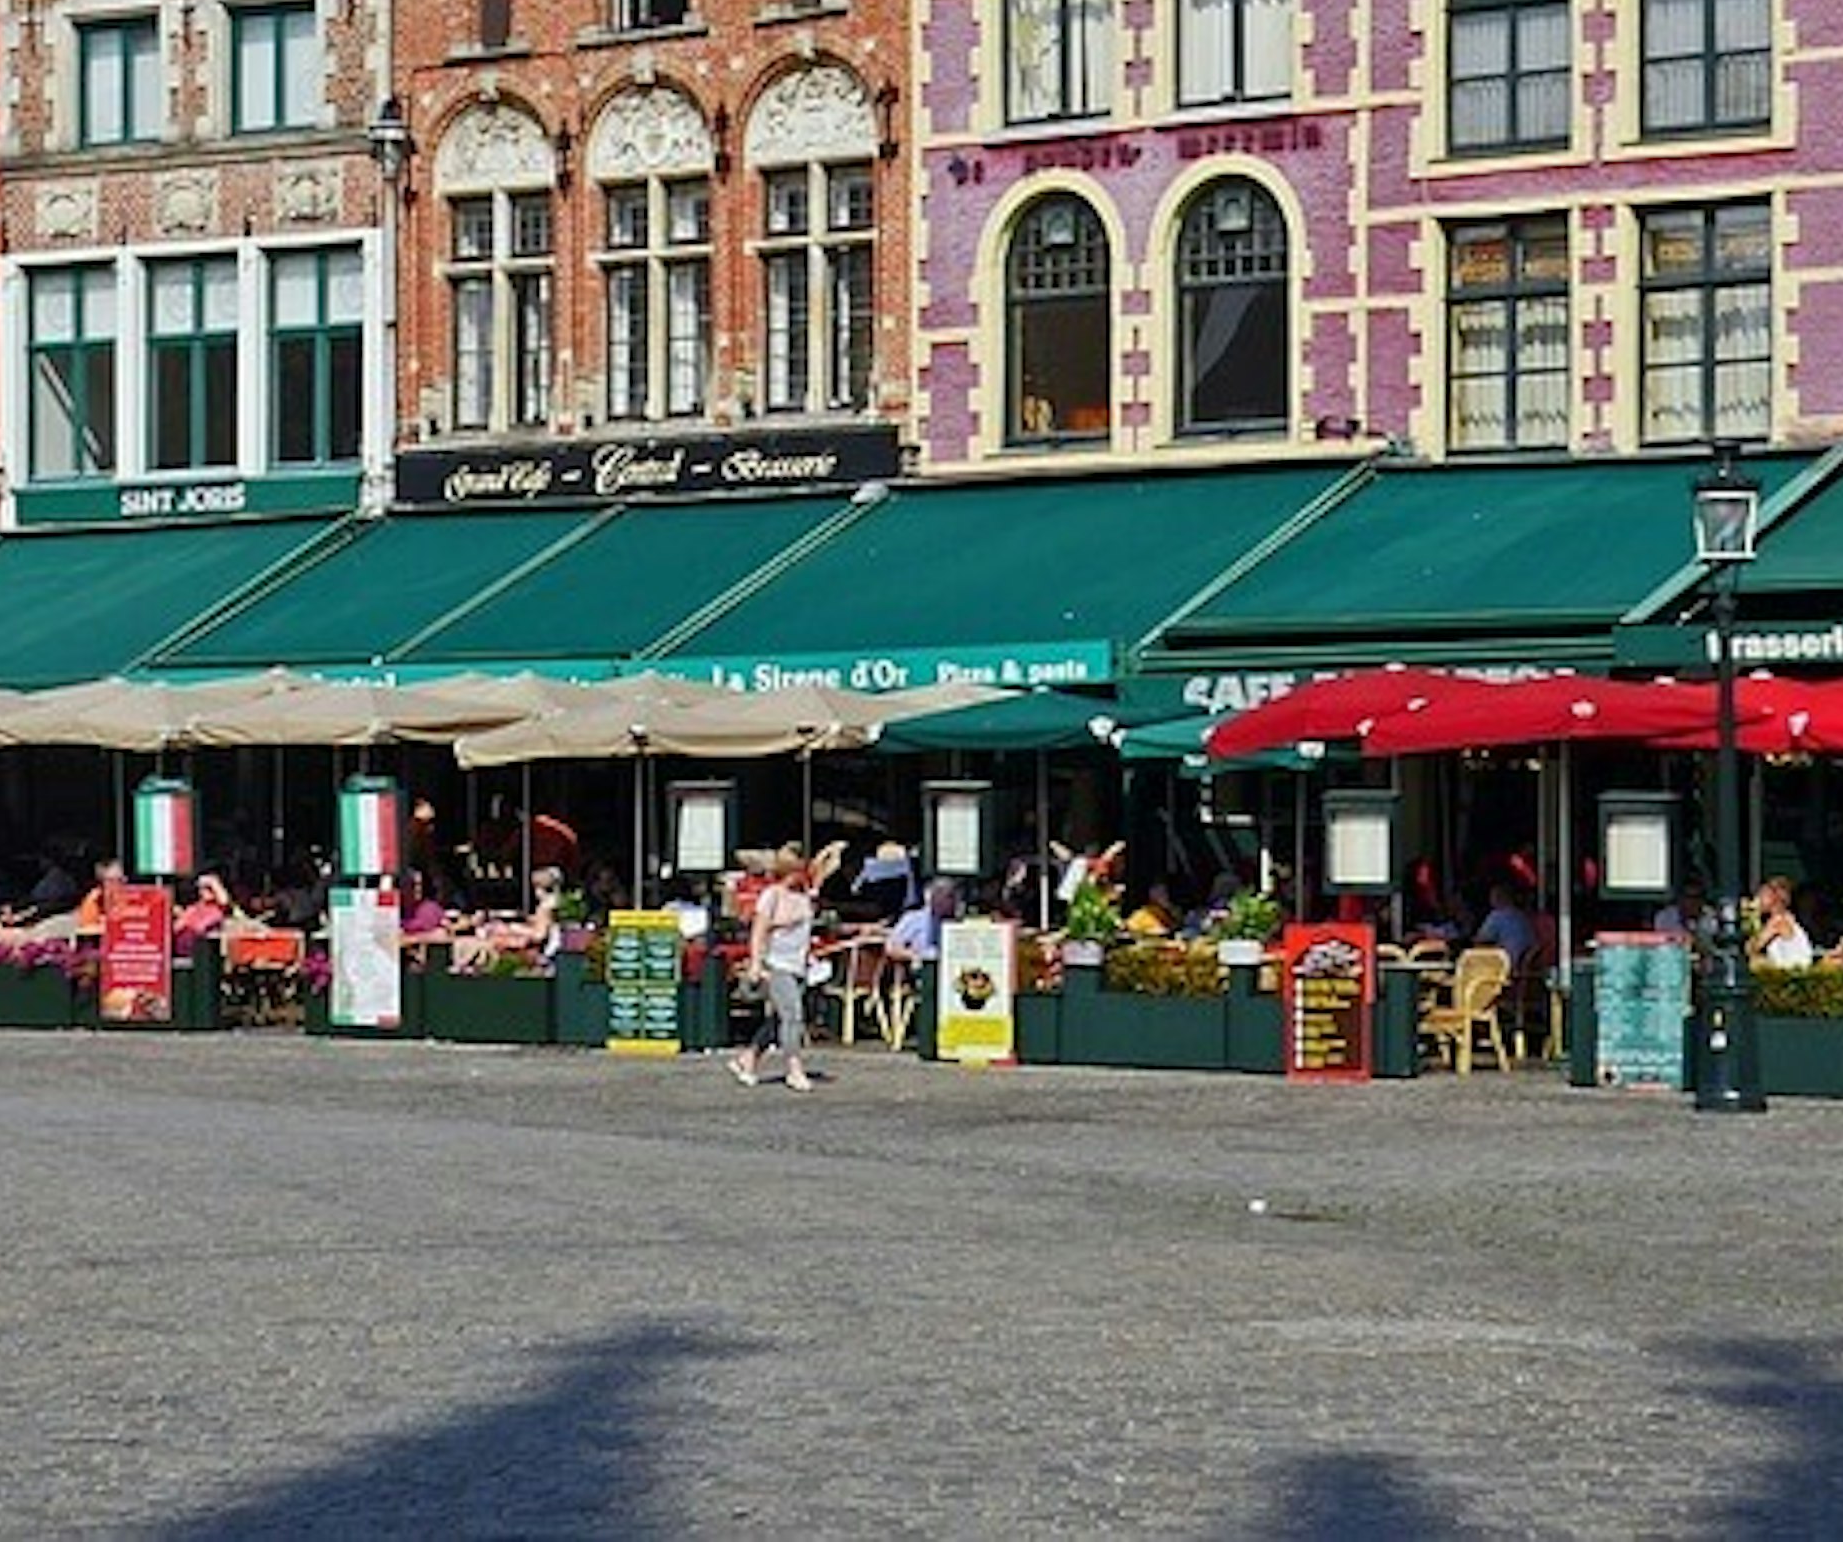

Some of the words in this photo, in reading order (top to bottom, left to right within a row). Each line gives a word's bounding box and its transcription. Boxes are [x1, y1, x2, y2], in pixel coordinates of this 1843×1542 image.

[120, 485, 175, 516] SINT
[178, 482, 246, 513] JORIS
[711, 664, 746, 693] La
[849, 659, 908, 689] d'Or
[1000, 659, 1024, 683] &
[1027, 660, 1088, 686] pasta
